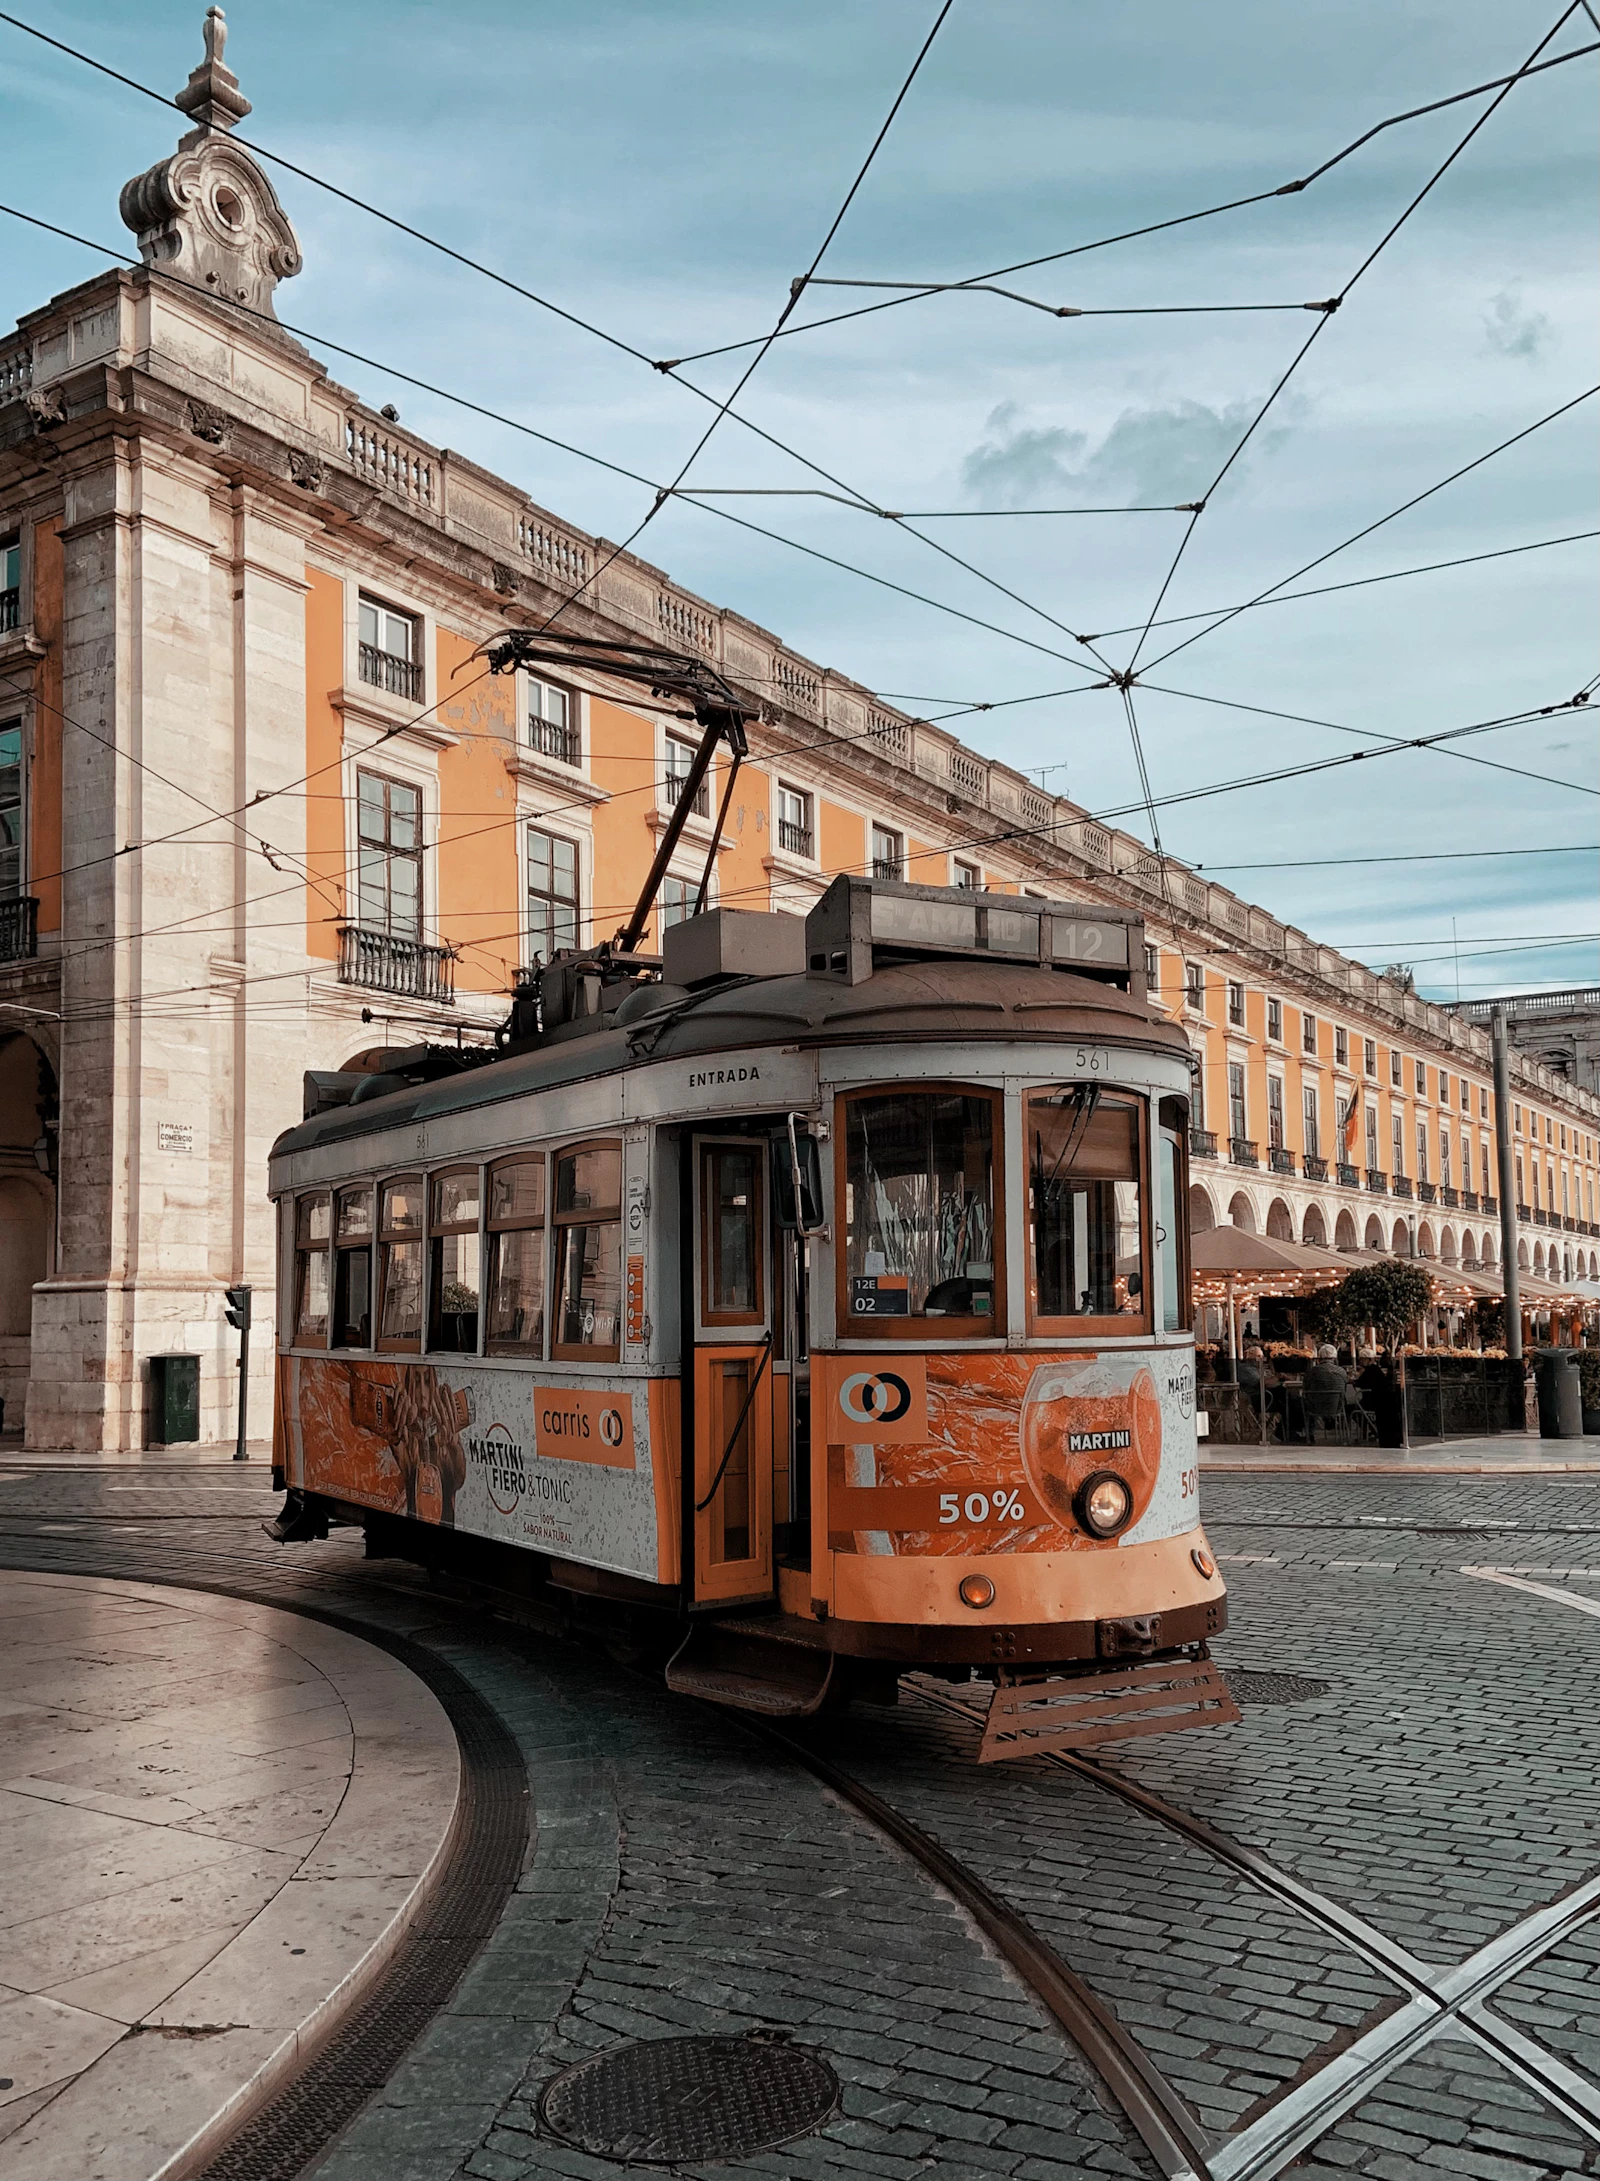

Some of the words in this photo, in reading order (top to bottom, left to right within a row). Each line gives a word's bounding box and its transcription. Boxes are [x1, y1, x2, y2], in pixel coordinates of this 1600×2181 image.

[909, 905, 1021, 942] AMARO
[1065, 924, 1102, 958] 12
[1076, 1048, 1109, 1071] 561
[689, 1066, 760, 1087] ENTRADA
[855, 1279, 876, 1290] 12E
[855, 1297, 876, 1312] 02
[543, 1403, 590, 1438] carris
[469, 1438, 524, 1471] MARTINI
[1069, 1430, 1130, 1451] MARTINI
[492, 1468, 526, 1494] FIERO
[527, 1474, 536, 1497] &
[535, 1475, 571, 1504] TONIC
[939, 1488, 1025, 1524] 50%
[523, 1521, 542, 1537] SABOR
[543, 1528, 572, 1544] NATURAL
